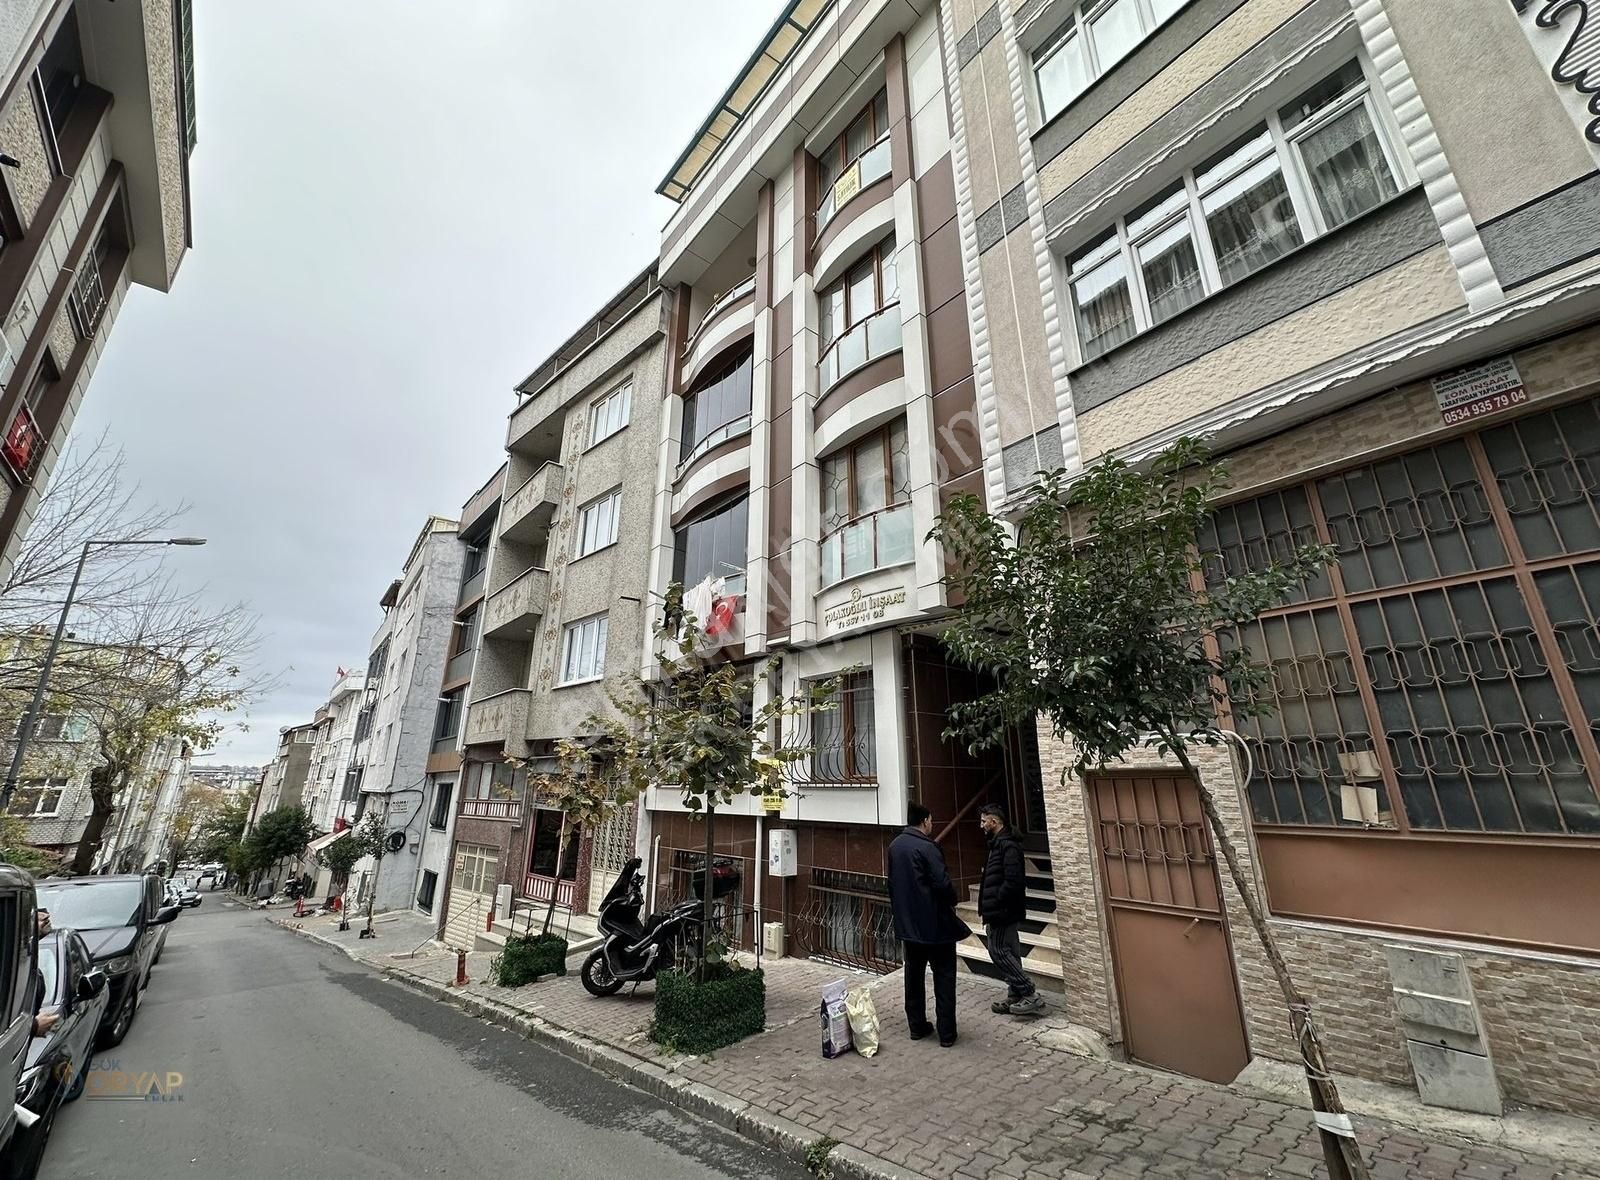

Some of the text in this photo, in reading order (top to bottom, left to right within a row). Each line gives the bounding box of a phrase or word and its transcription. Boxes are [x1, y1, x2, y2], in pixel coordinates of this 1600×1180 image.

[1440, 393, 1478, 408] TARAFINDAN
[1444, 389, 1526, 424] 0534 935 79 04
